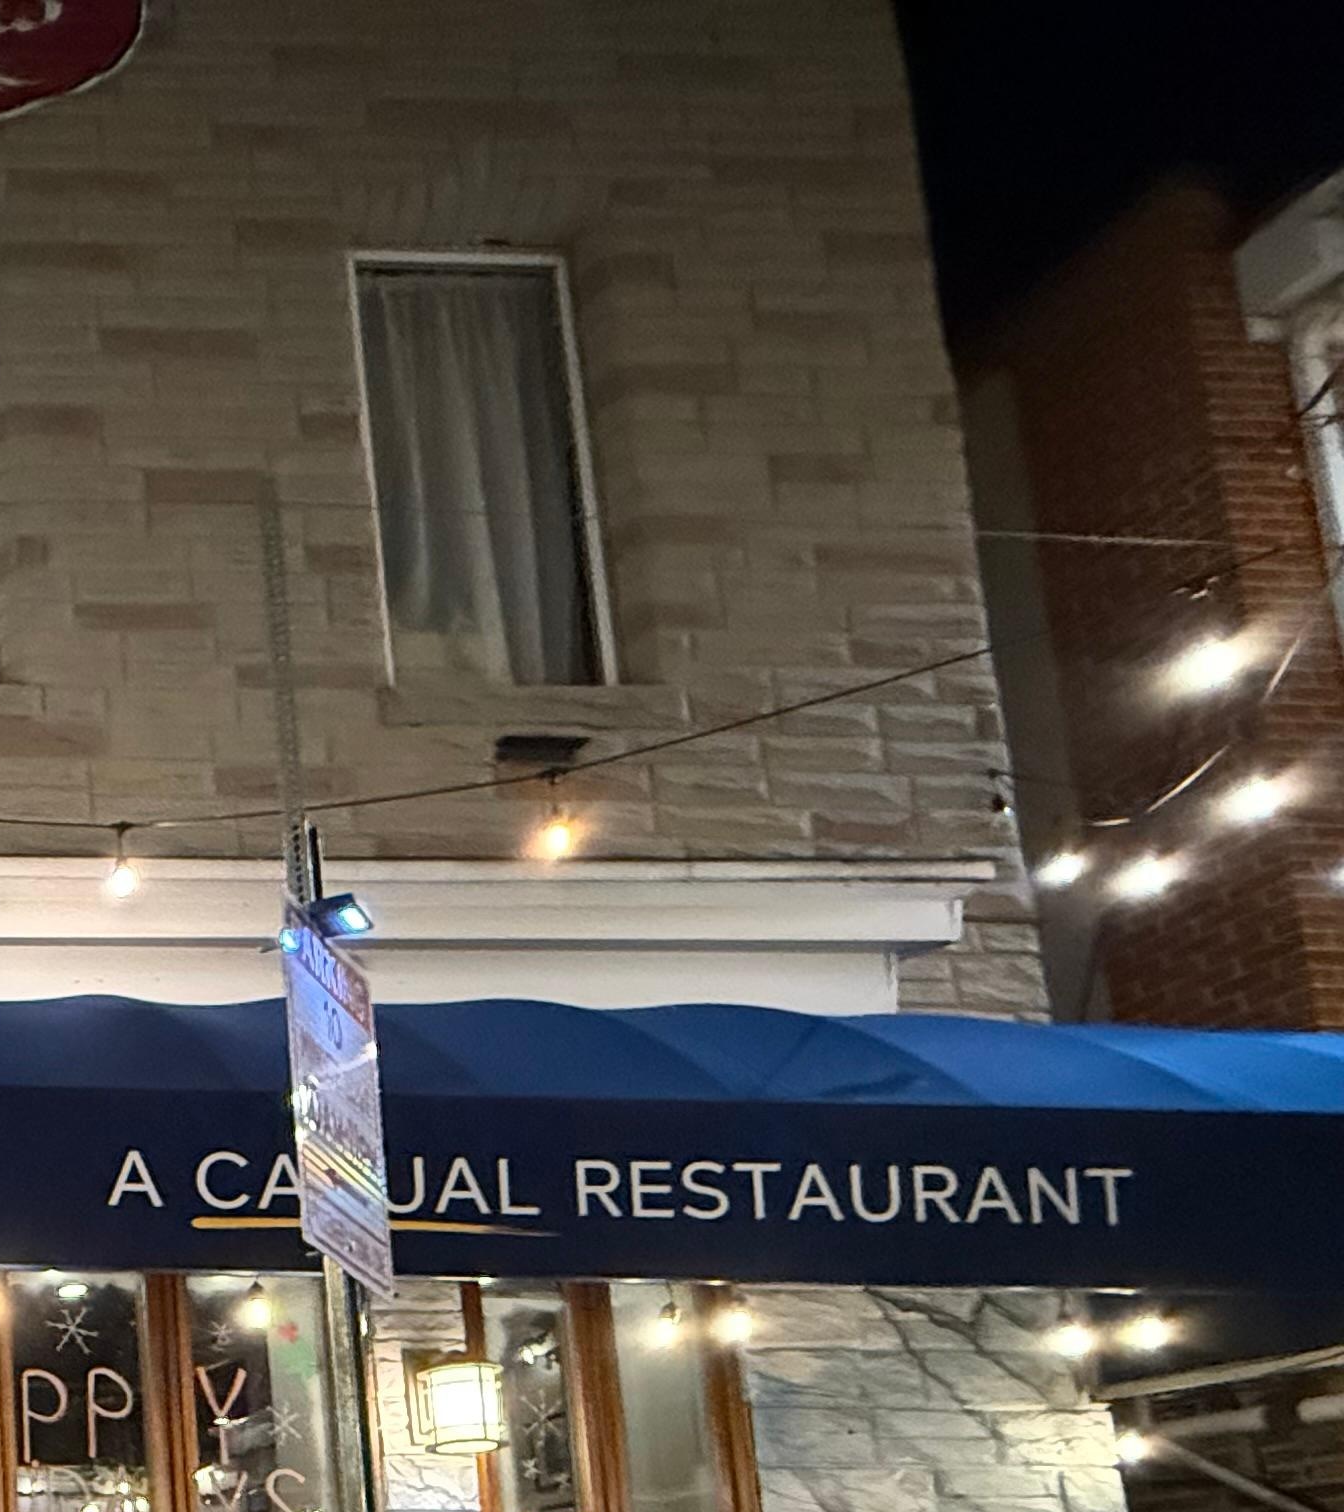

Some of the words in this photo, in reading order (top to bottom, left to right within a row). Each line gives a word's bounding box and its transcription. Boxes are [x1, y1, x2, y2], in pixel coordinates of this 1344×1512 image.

[107, 1149, 165, 1208] A
[195, 1150, 542, 1216] CAUAL
[574, 1158, 1135, 1228] RESTAURANT
